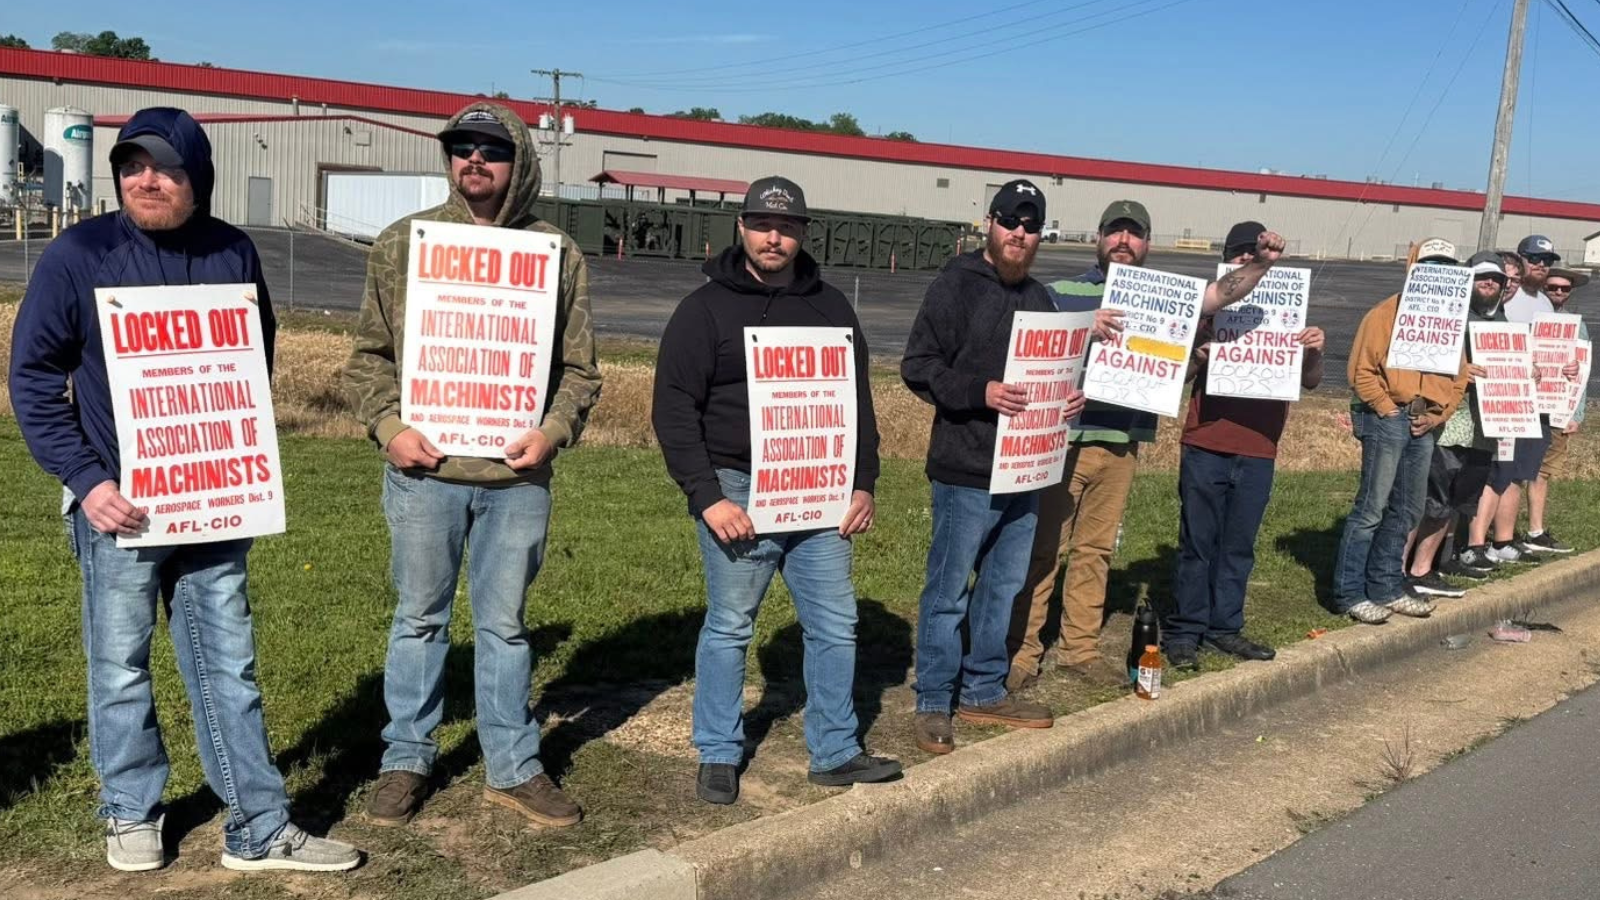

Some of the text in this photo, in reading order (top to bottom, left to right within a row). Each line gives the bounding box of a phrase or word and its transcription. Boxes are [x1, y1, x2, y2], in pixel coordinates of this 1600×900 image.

[418, 242, 549, 289] LOCKED OUT
[1112, 279, 1198, 301] ASSOCIATION OF
[1116, 268, 1198, 291] INTERNATIONAL
[1291, 282, 1304, 290] OF
[1407, 283, 1467, 298] MACHINISTS
[437, 294, 526, 310] MEMBERS OF THE
[1109, 290, 1195, 318] MACHINISTS
[111, 308, 250, 353] LOCKED OUT
[421, 310, 537, 345] INTERNATIONAL
[1399, 314, 1462, 332] ON STRIKE
[1534, 322, 1577, 339] LOCKED OUT
[1015, 328, 1089, 358] LOCKED OUT
[1218, 328, 1299, 348] ON STRIKE
[1396, 328, 1459, 346] AGAINST
[1475, 332, 1526, 351] LOCKED OUT
[418, 345, 536, 379] ASSOCIATION OF
[753, 347, 847, 378] LOCKED OUT
[1095, 350, 1181, 380] AGAINST
[1215, 346, 1297, 366] AGAINST
[142, 363, 236, 378] MEMBERS OF THE
[129, 380, 256, 419] INTERNATIONAL
[411, 379, 537, 412] MACHINISTS
[1483, 400, 1534, 414] MACHINISTS
[410, 414, 424, 422] AND
[429, 414, 470, 425] AEROSPACE
[476, 417, 509, 427] WORKERS
[762, 404, 846, 431] INTERNATIONAL
[137, 417, 257, 459] ASSOCIATION OF
[762, 434, 845, 463] ASSOCIATION OF
[1001, 429, 1067, 457] MACHINISTS
[131, 454, 270, 498] MACHINISTS
[757, 464, 847, 493] MACHINISTS
[155, 500, 202, 515] AEROSPACE
[208, 494, 245, 508] WORKERS
[268, 491, 273, 500] 9
